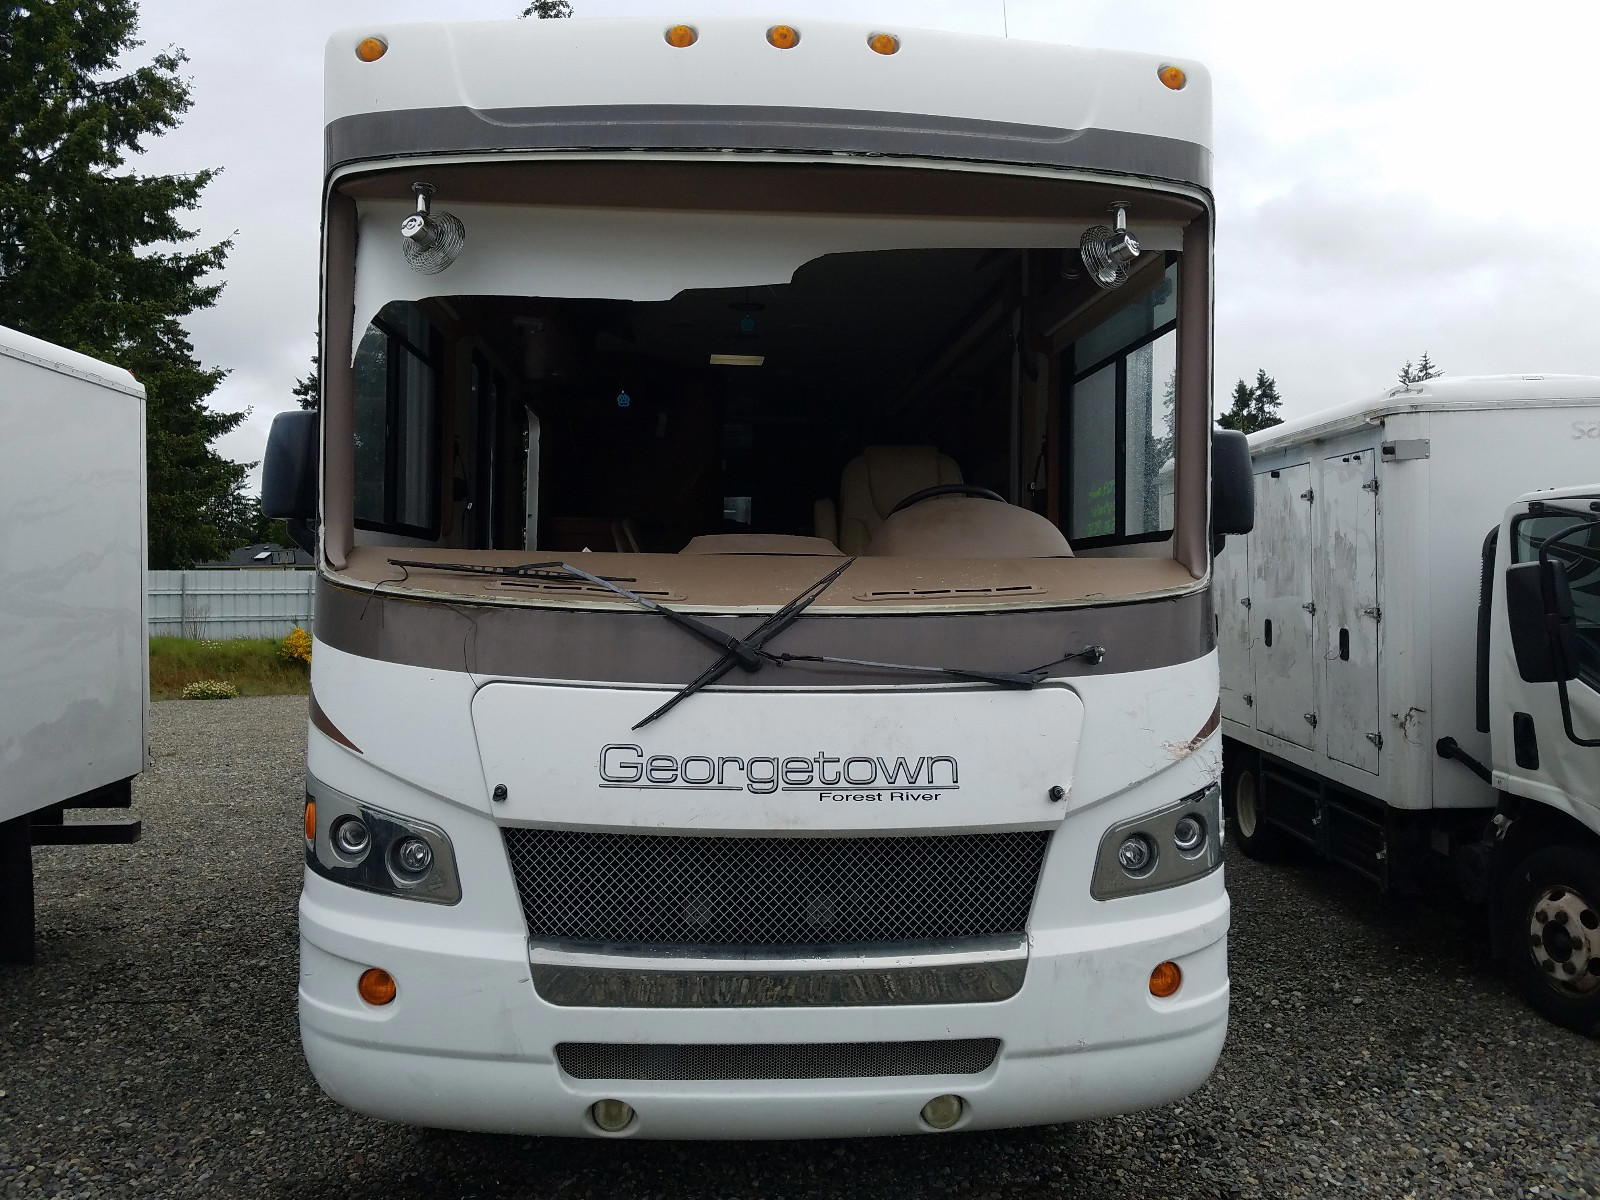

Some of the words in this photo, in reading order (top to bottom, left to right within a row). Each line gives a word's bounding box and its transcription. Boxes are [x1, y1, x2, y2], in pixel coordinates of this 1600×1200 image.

[599, 743, 959, 795] Georgetown
[819, 792, 883, 802] Forest
[890, 791, 942, 802] River
